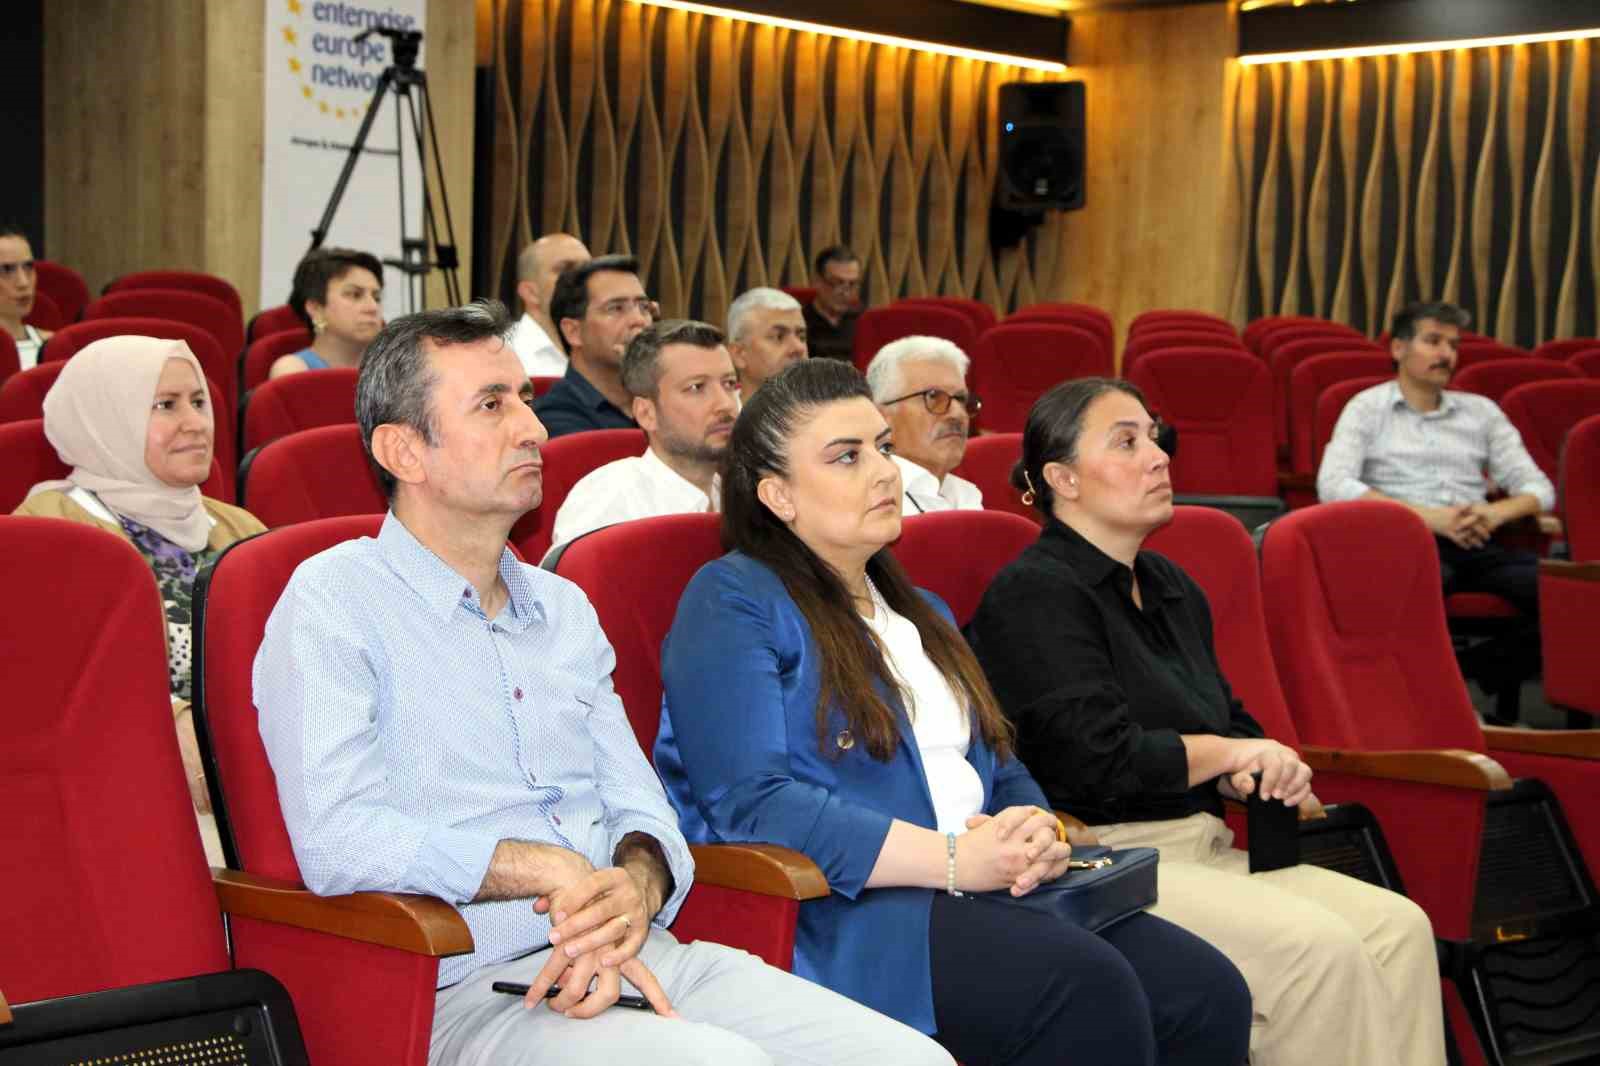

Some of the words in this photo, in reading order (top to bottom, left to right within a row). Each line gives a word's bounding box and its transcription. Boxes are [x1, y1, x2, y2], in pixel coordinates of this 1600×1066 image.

[313, 1, 415, 31] enterprise
[312, 33, 385, 65] europe
[312, 64, 379, 91] netwo
